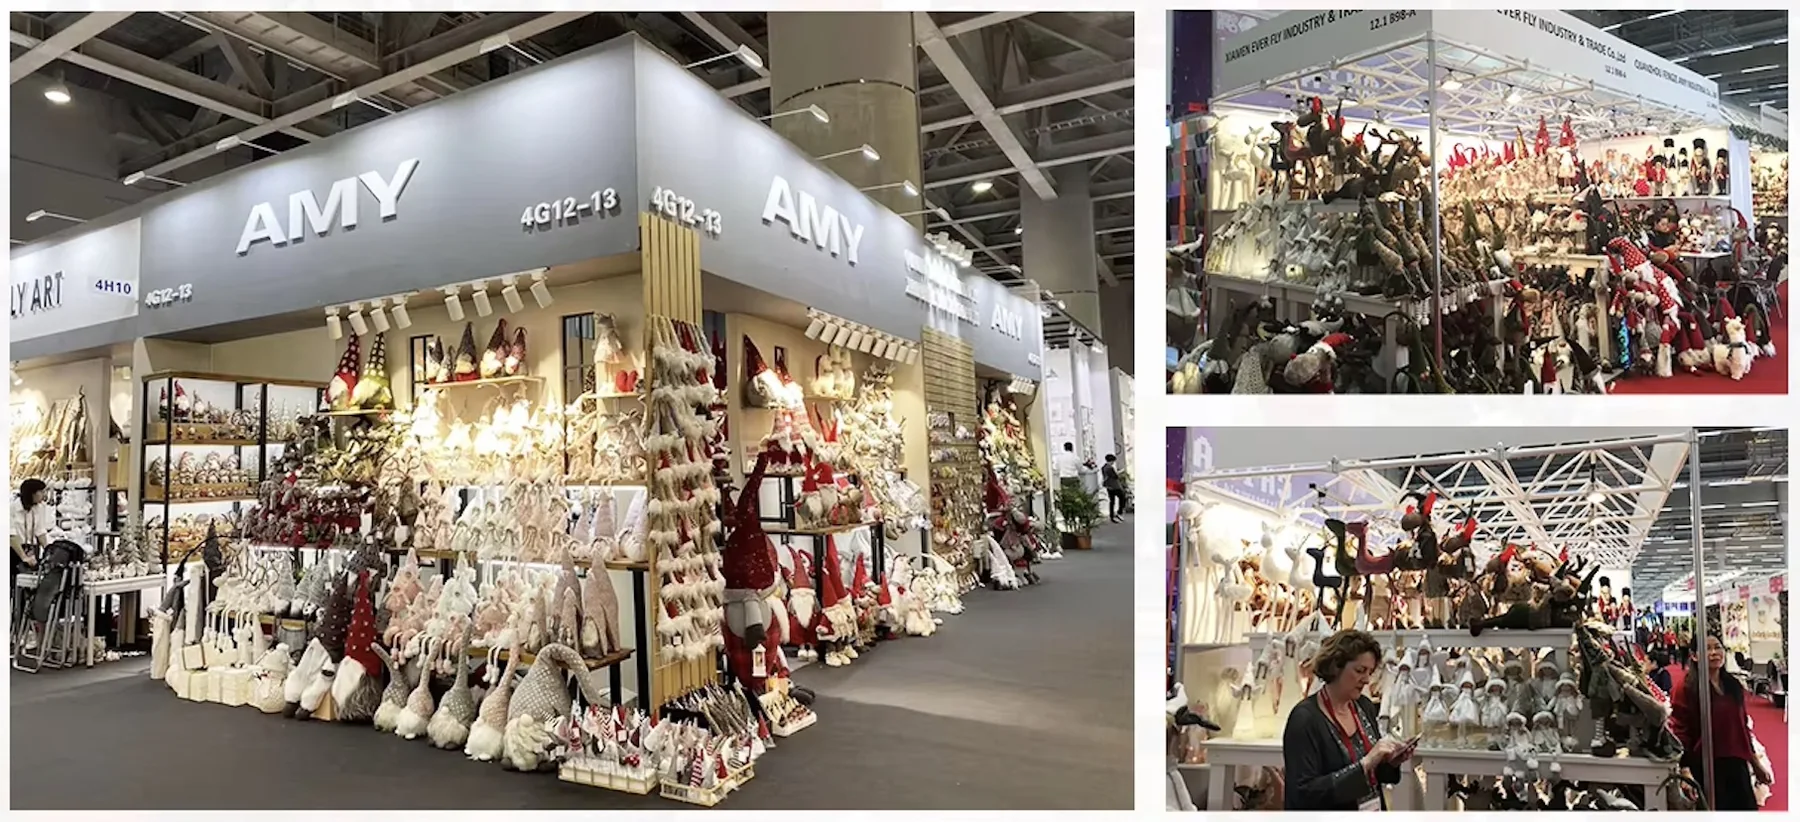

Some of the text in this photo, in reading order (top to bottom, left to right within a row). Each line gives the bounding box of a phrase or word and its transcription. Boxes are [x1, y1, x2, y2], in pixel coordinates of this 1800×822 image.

[1270, 31, 1282, 45] FLY
[1283, 13, 1325, 41] INDUSTRY
[1327, 9, 1336, 23] &
[1370, 15, 1387, 31] 12.1
[1523, 11, 1537, 28] FLY
[1539, 17, 1577, 43] INDUSTRY
[1578, 34, 1585, 46] &
[235, 157, 420, 258] AMY
[520, 187, 619, 228] 4G12-13
[651, 185, 722, 236] 4G12-13
[761, 174, 865, 267] AMY
[30, 271, 64, 314] ART
[95, 280, 131, 294] 4H10
[990, 303, 1023, 341] AMY
